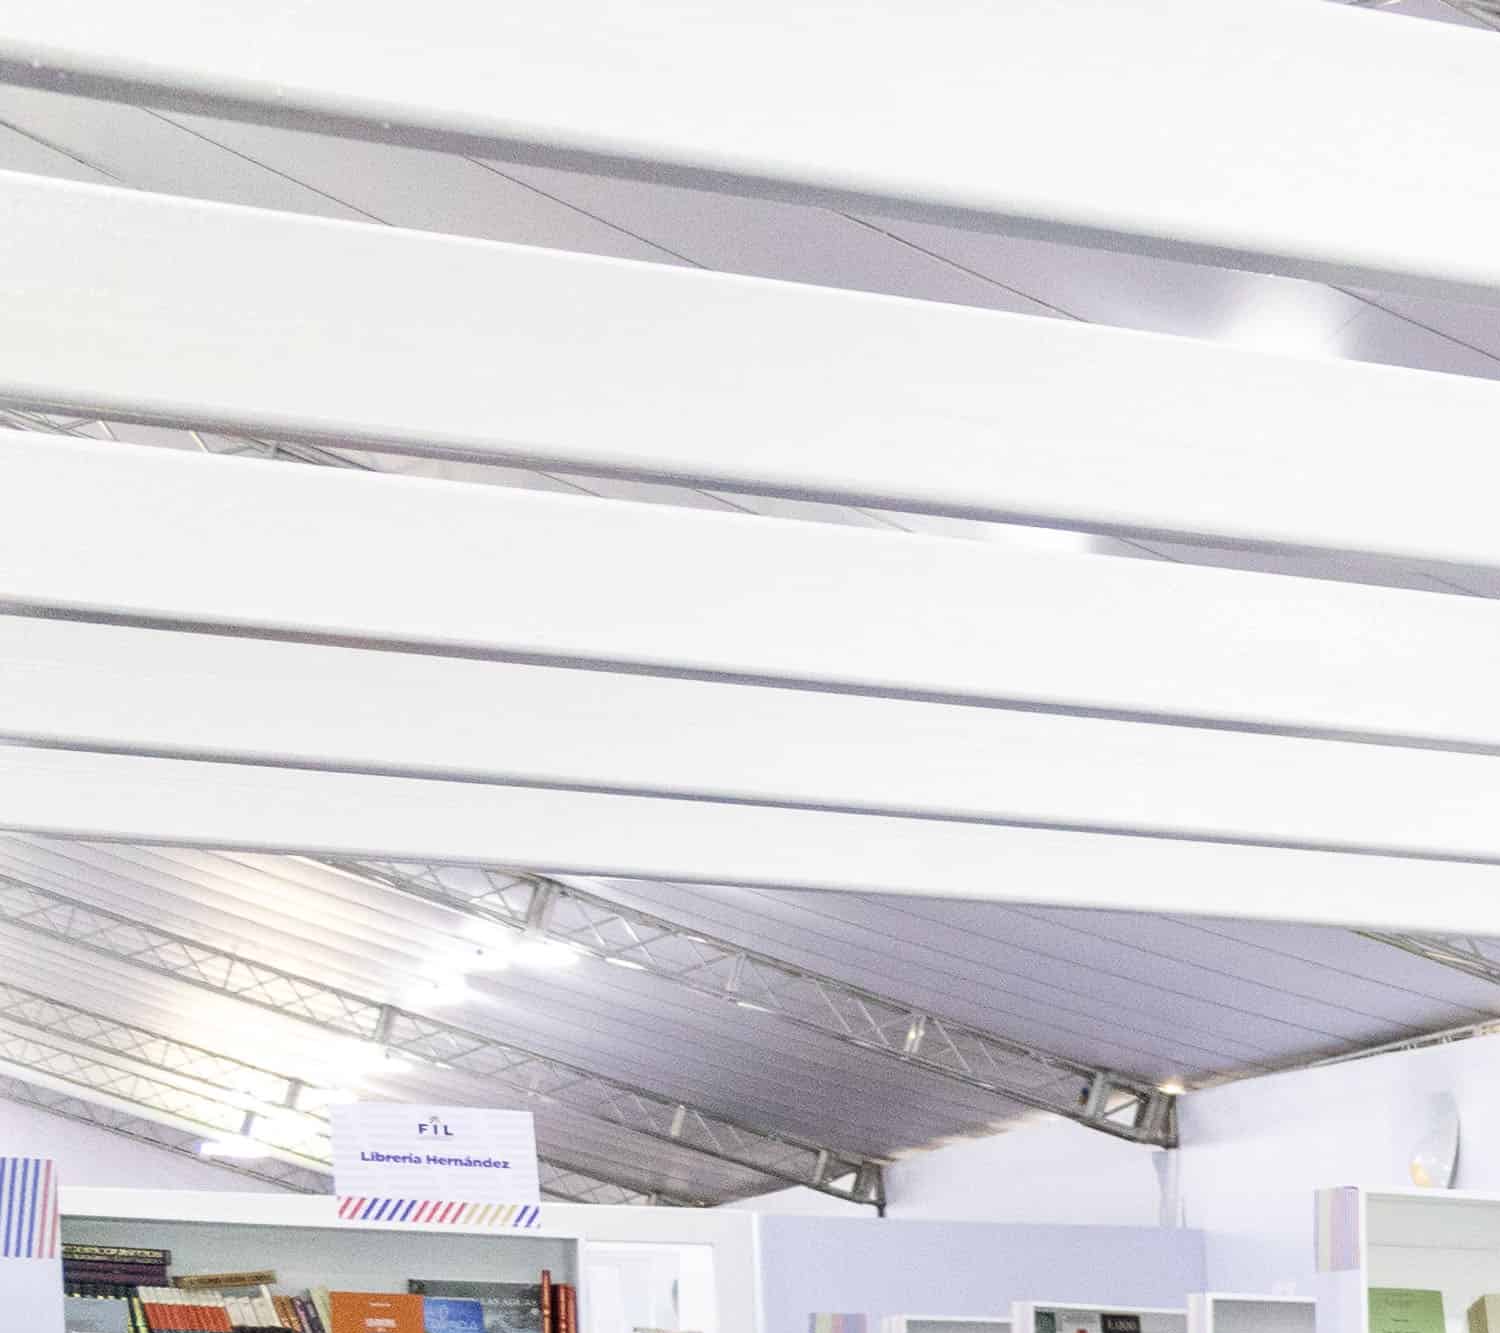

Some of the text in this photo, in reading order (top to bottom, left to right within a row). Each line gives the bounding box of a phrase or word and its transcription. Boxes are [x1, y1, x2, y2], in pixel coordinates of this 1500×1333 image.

[418, 1123, 454, 1136] FIL
[360, 1151, 511, 1169] Librería Hernández
